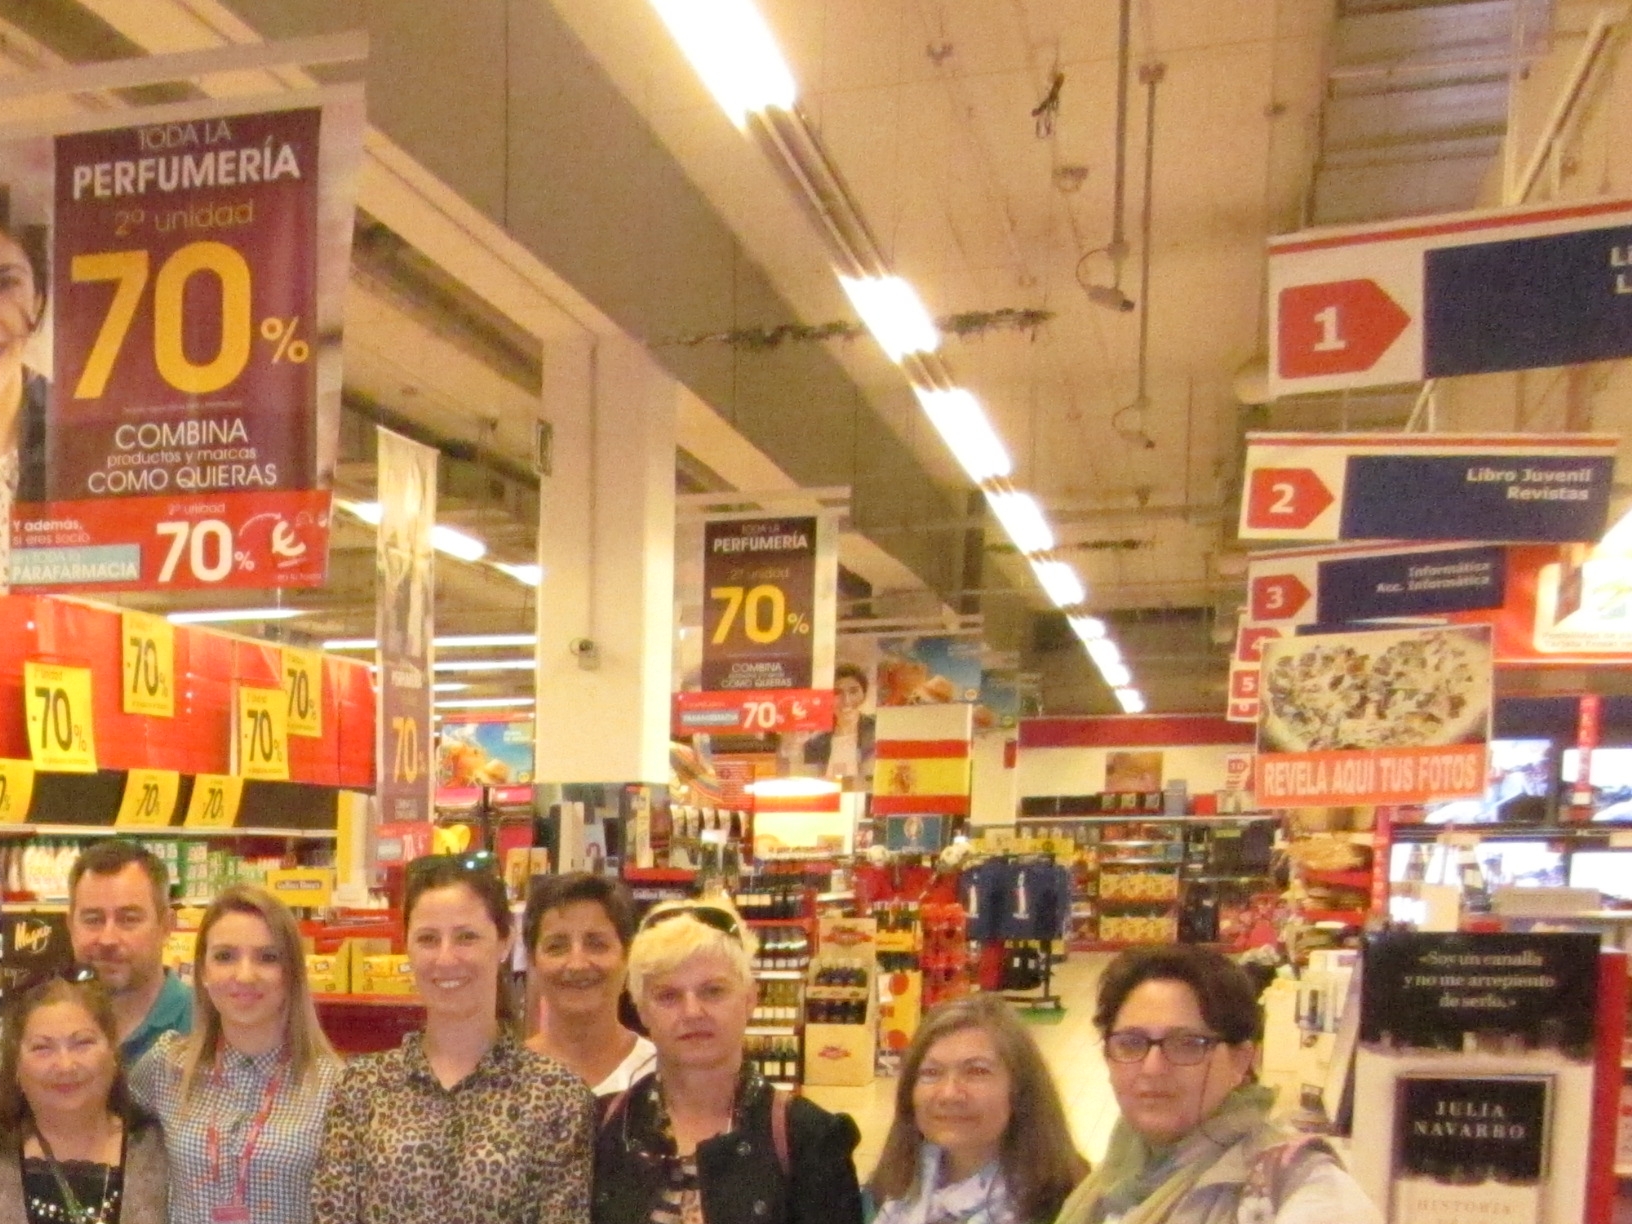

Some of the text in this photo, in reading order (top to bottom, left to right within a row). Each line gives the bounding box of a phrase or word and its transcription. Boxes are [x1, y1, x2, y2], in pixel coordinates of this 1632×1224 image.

[72, 134, 301, 200] PERFUMERÍA
[154, 199, 255, 232] unidad
[1313, 306, 1346, 351] 1
[115, 418, 248, 449] COMBINA
[107, 448, 256, 468] productos y marcas
[88, 463, 277, 493] COMO QUIERAS
[1466, 468, 1591, 482] Libro Juvenil
[1269, 483, 1295, 513] 2
[1507, 486, 1589, 500] Revistas
[55, 533, 90, 544] socio
[714, 531, 807, 552] PERFUMERÍA
[12, 561, 137, 580] PARAFARMACIA
[1408, 562, 1490, 577] Informática
[1408, 575, 1490, 591] Informática
[1267, 586, 1284, 609] 3
[732, 662, 782, 673] COMBINA
[1241, 677, 1255, 692] 5
[1264, 760, 1328, 797] REVELA
[1379, 757, 1414, 791] TUS
[1418, 753, 1477, 790] FOTOS
[1460, 955, 1481, 966] un
[1483, 950, 1543, 966] canalla
[1403, 975, 1555, 990] y no me arrepiento
[1439, 992, 1459, 1007] de
[1435, 1100, 1505, 1118] JULIA
[1414, 1121, 1525, 1139] NAVARRO
